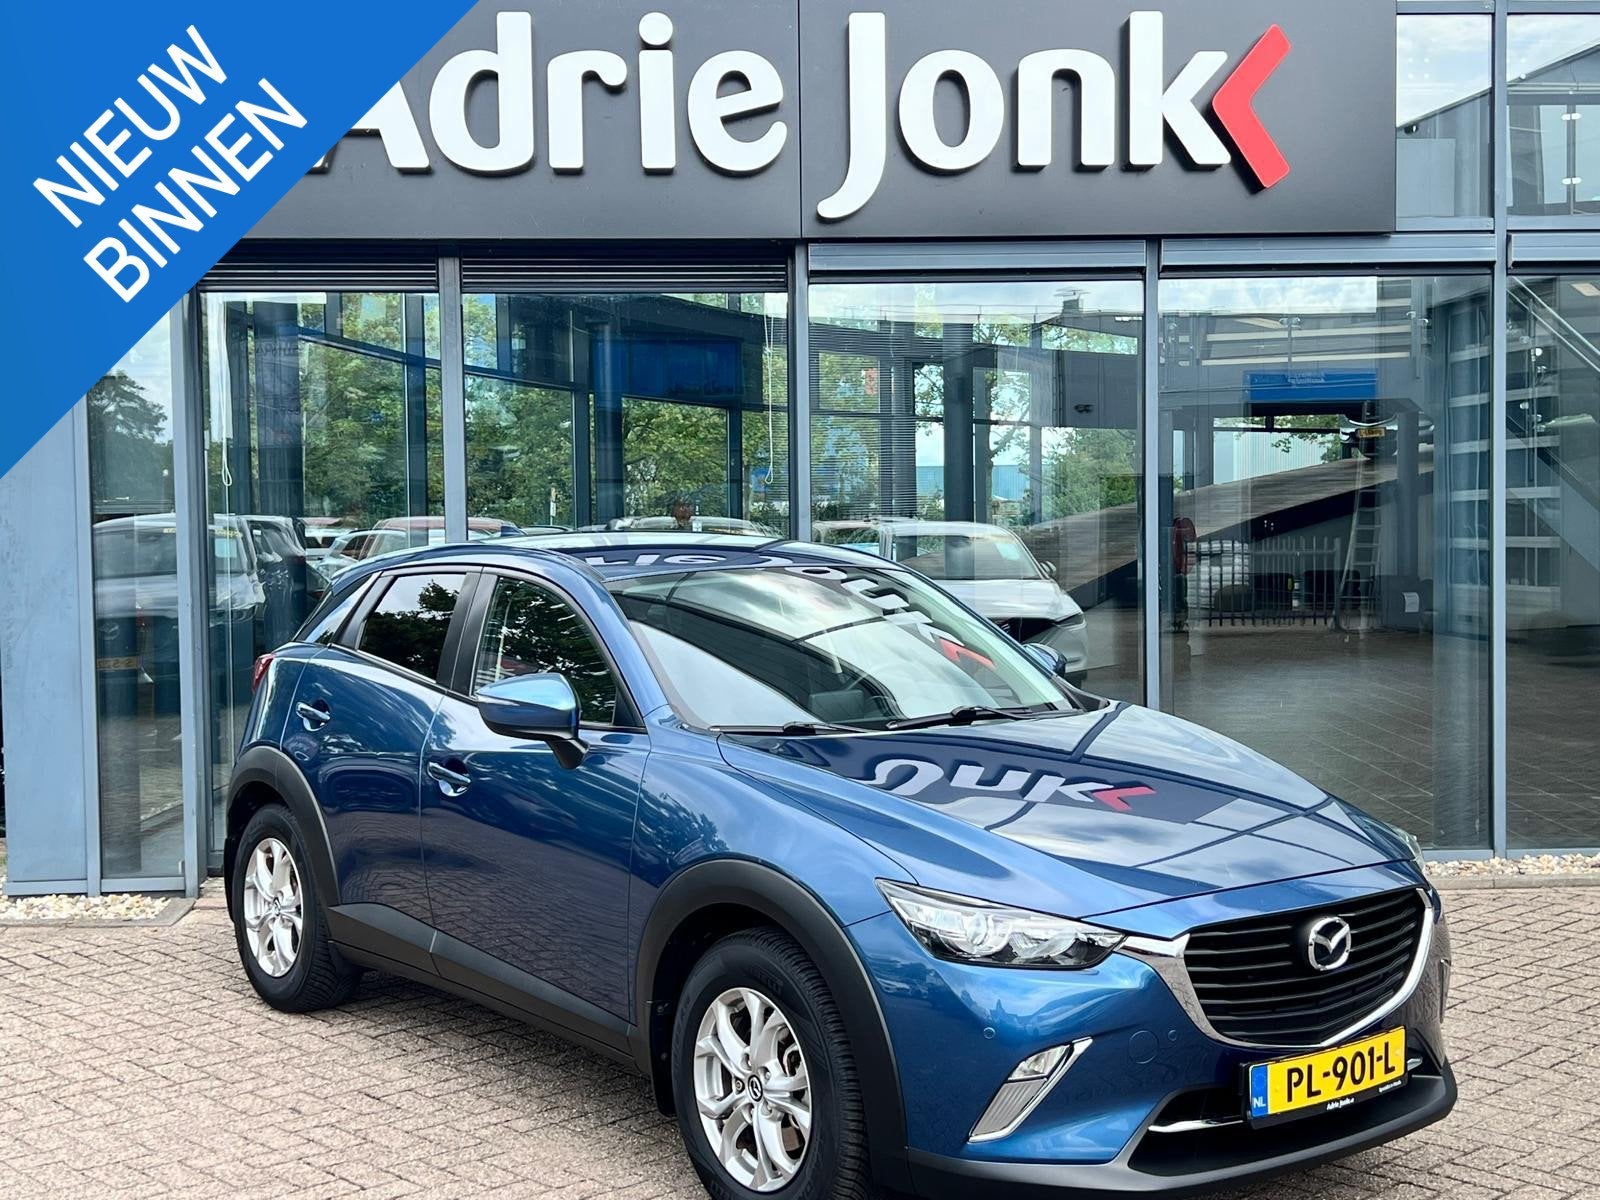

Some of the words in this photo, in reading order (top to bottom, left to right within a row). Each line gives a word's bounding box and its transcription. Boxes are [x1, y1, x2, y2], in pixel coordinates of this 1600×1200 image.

[816, 11, 1231, 219] Jonk
[1252, 1096, 1267, 1108] NL
[1286, 1041, 1396, 1103] PL-901-L
